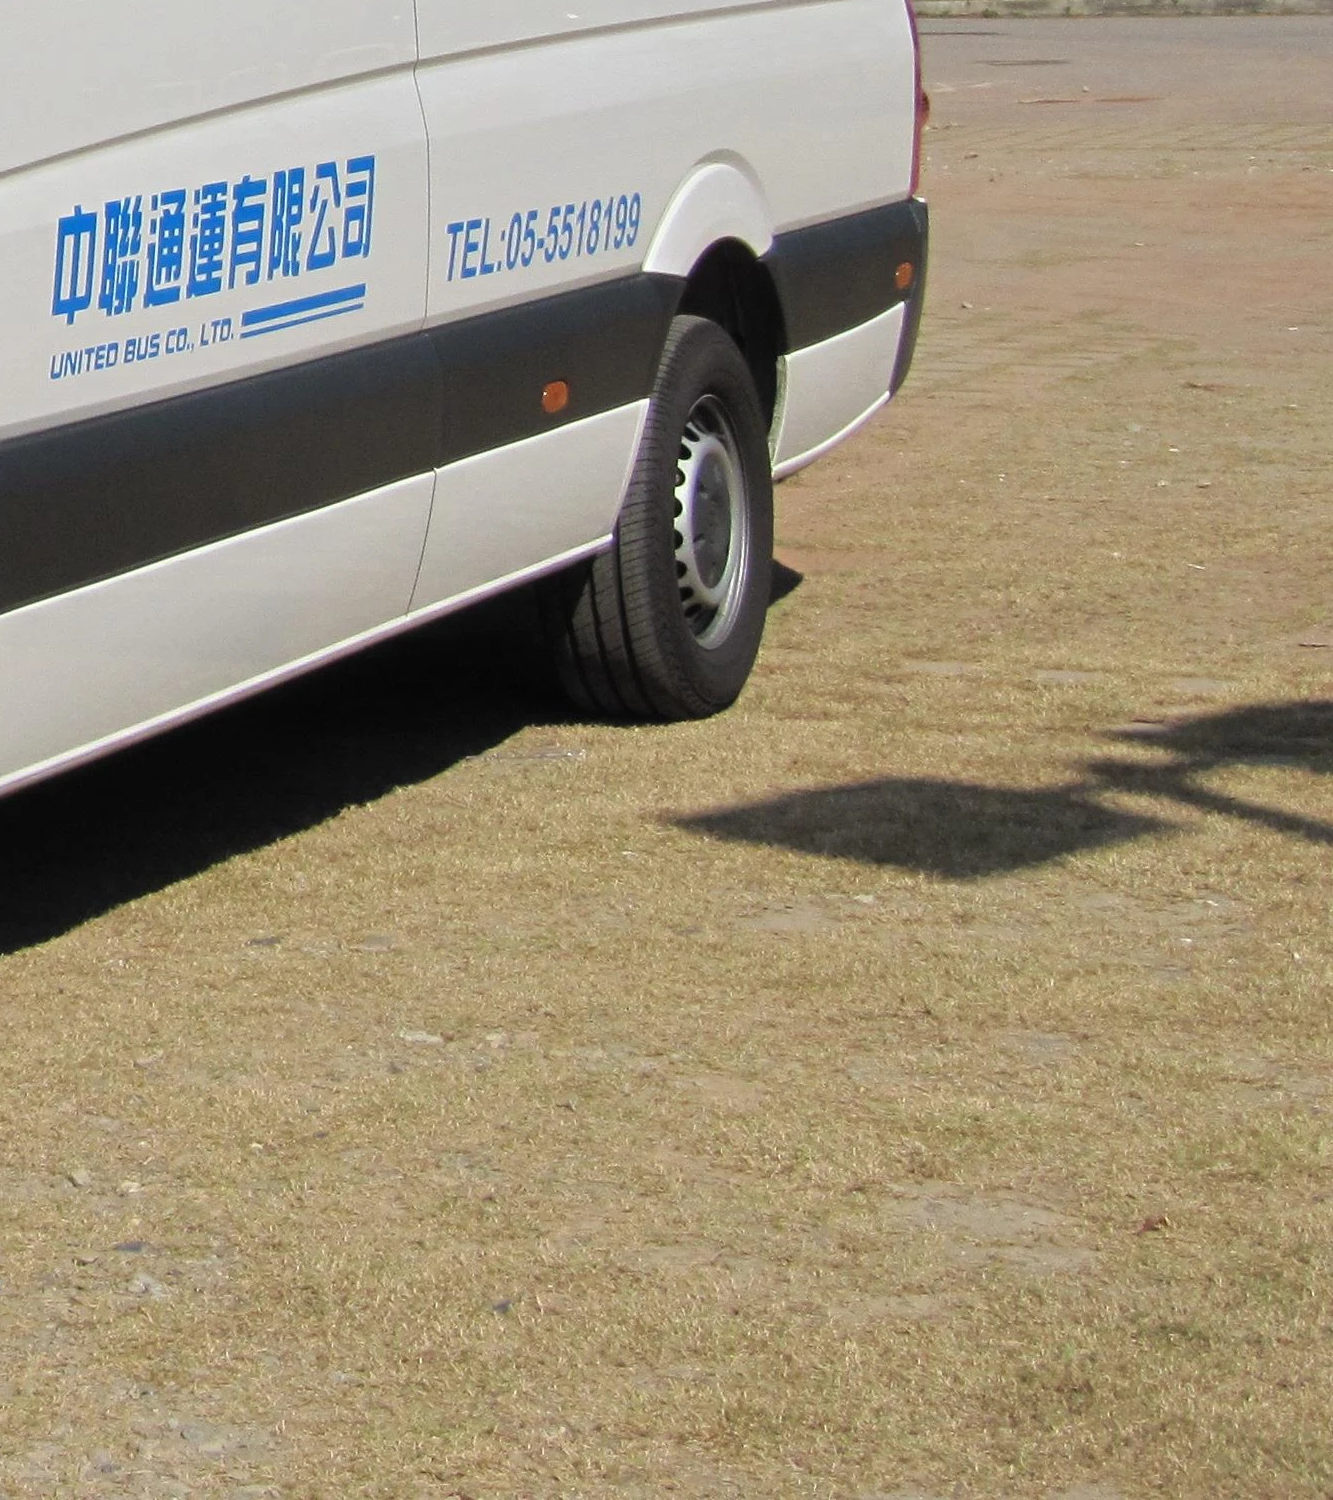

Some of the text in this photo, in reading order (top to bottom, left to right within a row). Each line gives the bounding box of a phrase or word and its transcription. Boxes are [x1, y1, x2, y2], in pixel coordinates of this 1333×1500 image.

[50, 154, 376, 325] 中聯通運有限公司
[50, 342, 119, 380] UNITED
[123, 332, 161, 364] BUS
[199, 317, 235, 347] LTD.
